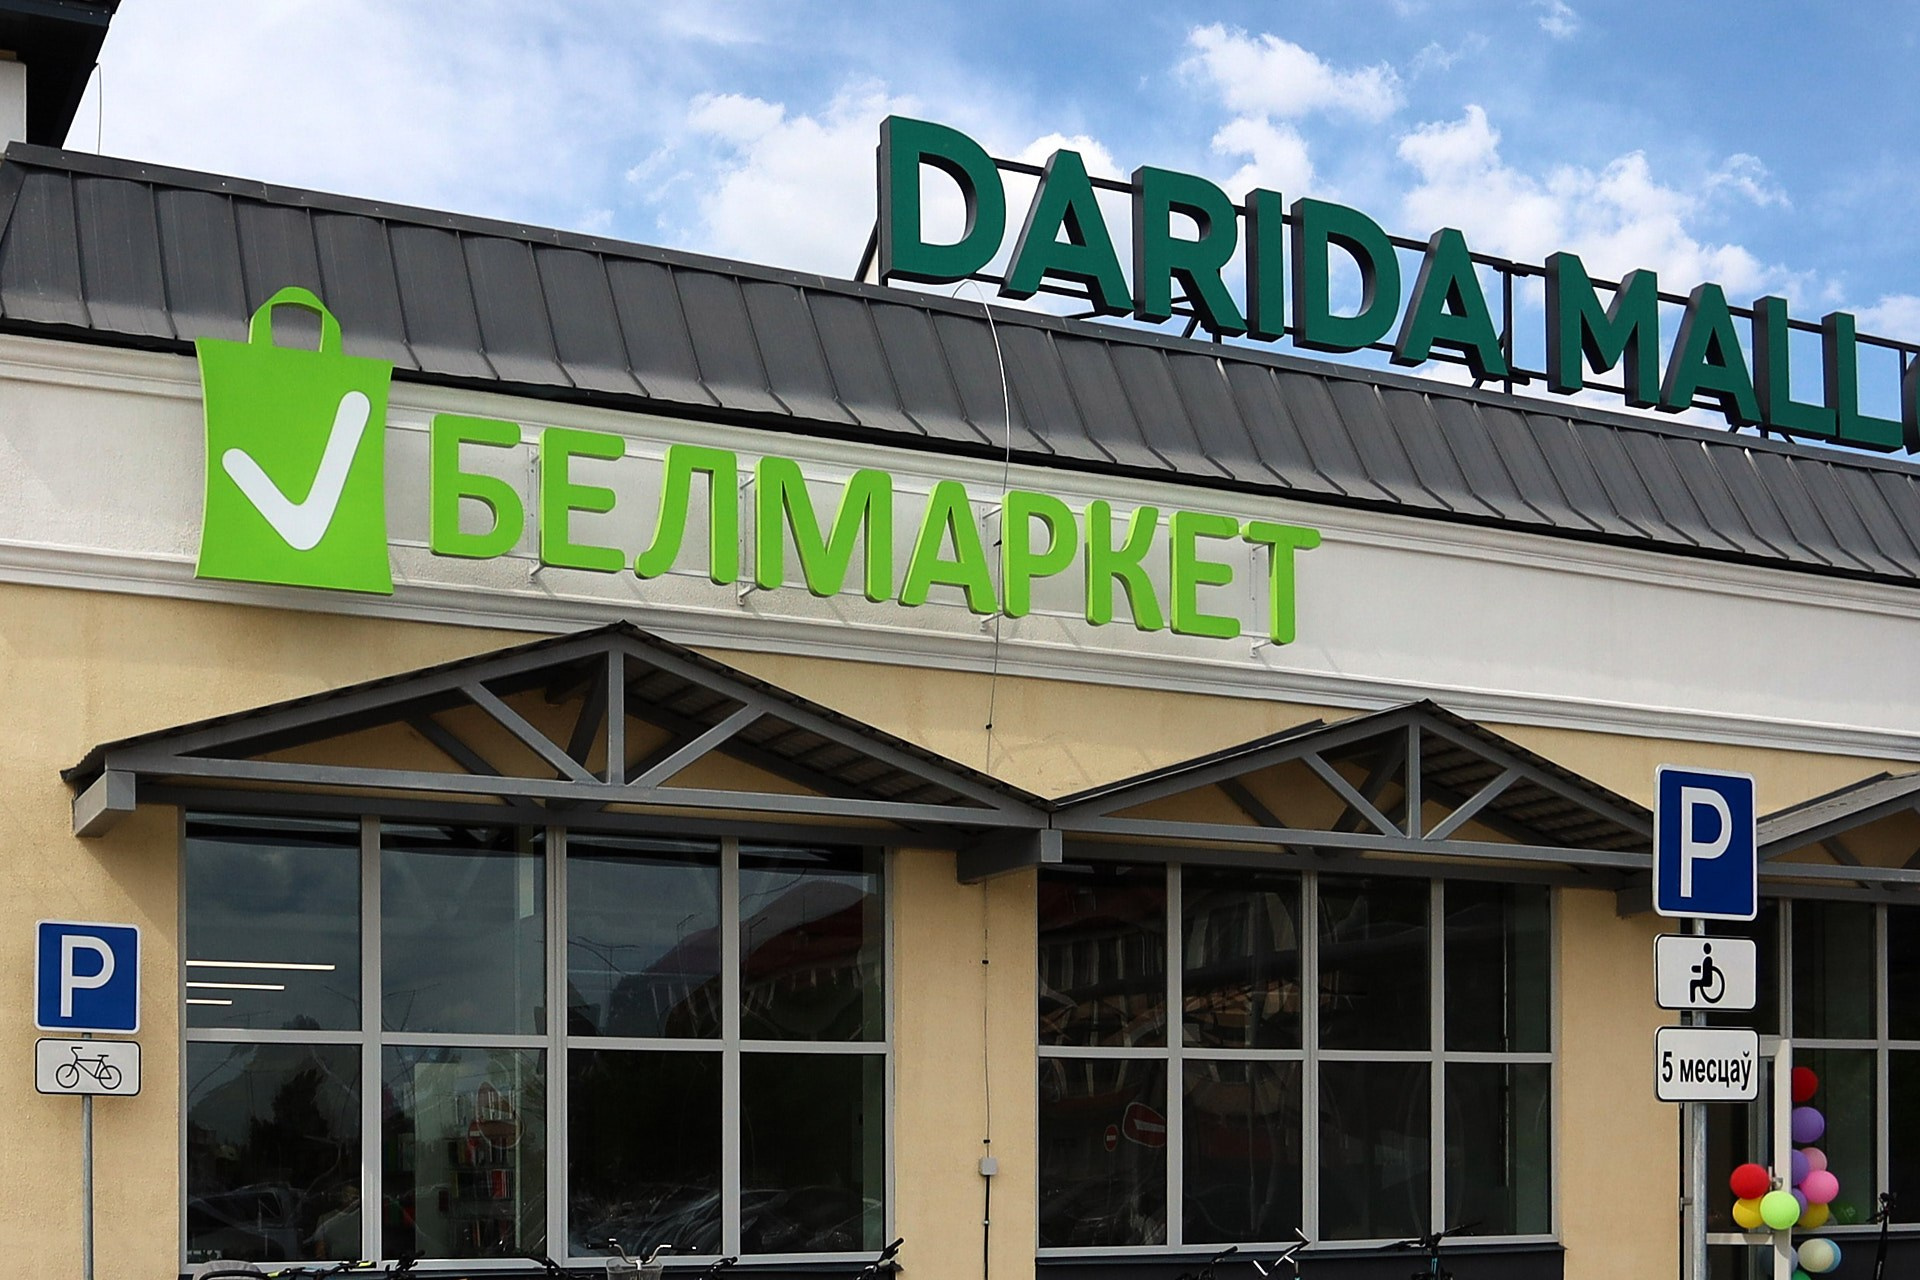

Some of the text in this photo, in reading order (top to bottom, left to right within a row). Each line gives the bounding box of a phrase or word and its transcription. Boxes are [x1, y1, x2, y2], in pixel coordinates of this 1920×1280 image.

[879, 114, 1511, 379] DARIDA
[1545, 252, 1903, 453] MALL
[429, 413, 1321, 645] БЕЛМАРКЕТ
[1680, 786, 1732, 897] P
[60, 934, 115, 1017] P
[1662, 1050, 1752, 1091] 5 месцаў
